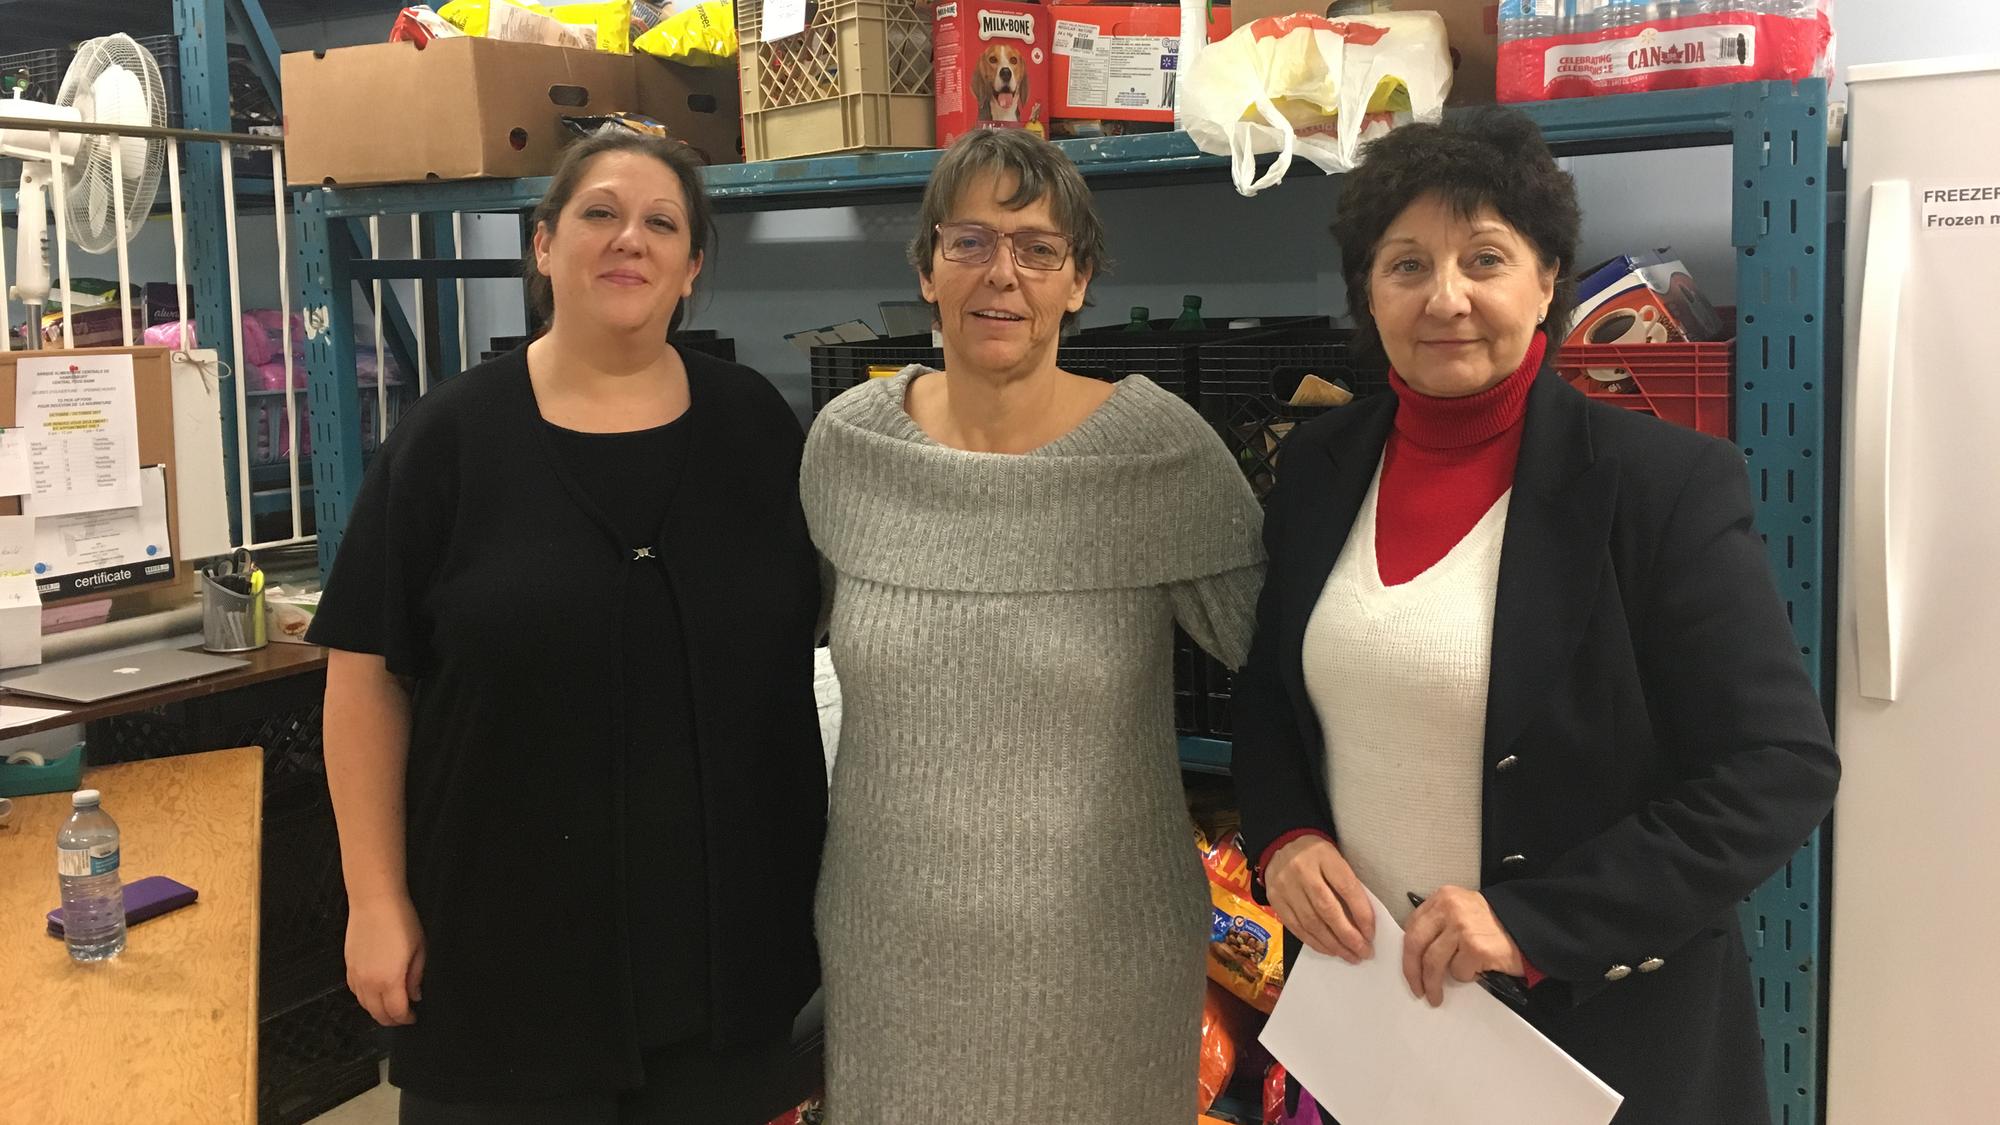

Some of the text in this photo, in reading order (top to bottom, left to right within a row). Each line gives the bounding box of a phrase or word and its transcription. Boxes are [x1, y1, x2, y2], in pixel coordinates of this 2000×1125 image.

[1559, 54, 1612, 64] CELEBRATING
[1928, 214, 1984, 227] Frozen
[154, 307, 180, 318] alwa
[75, 569, 132, 588] certificate
